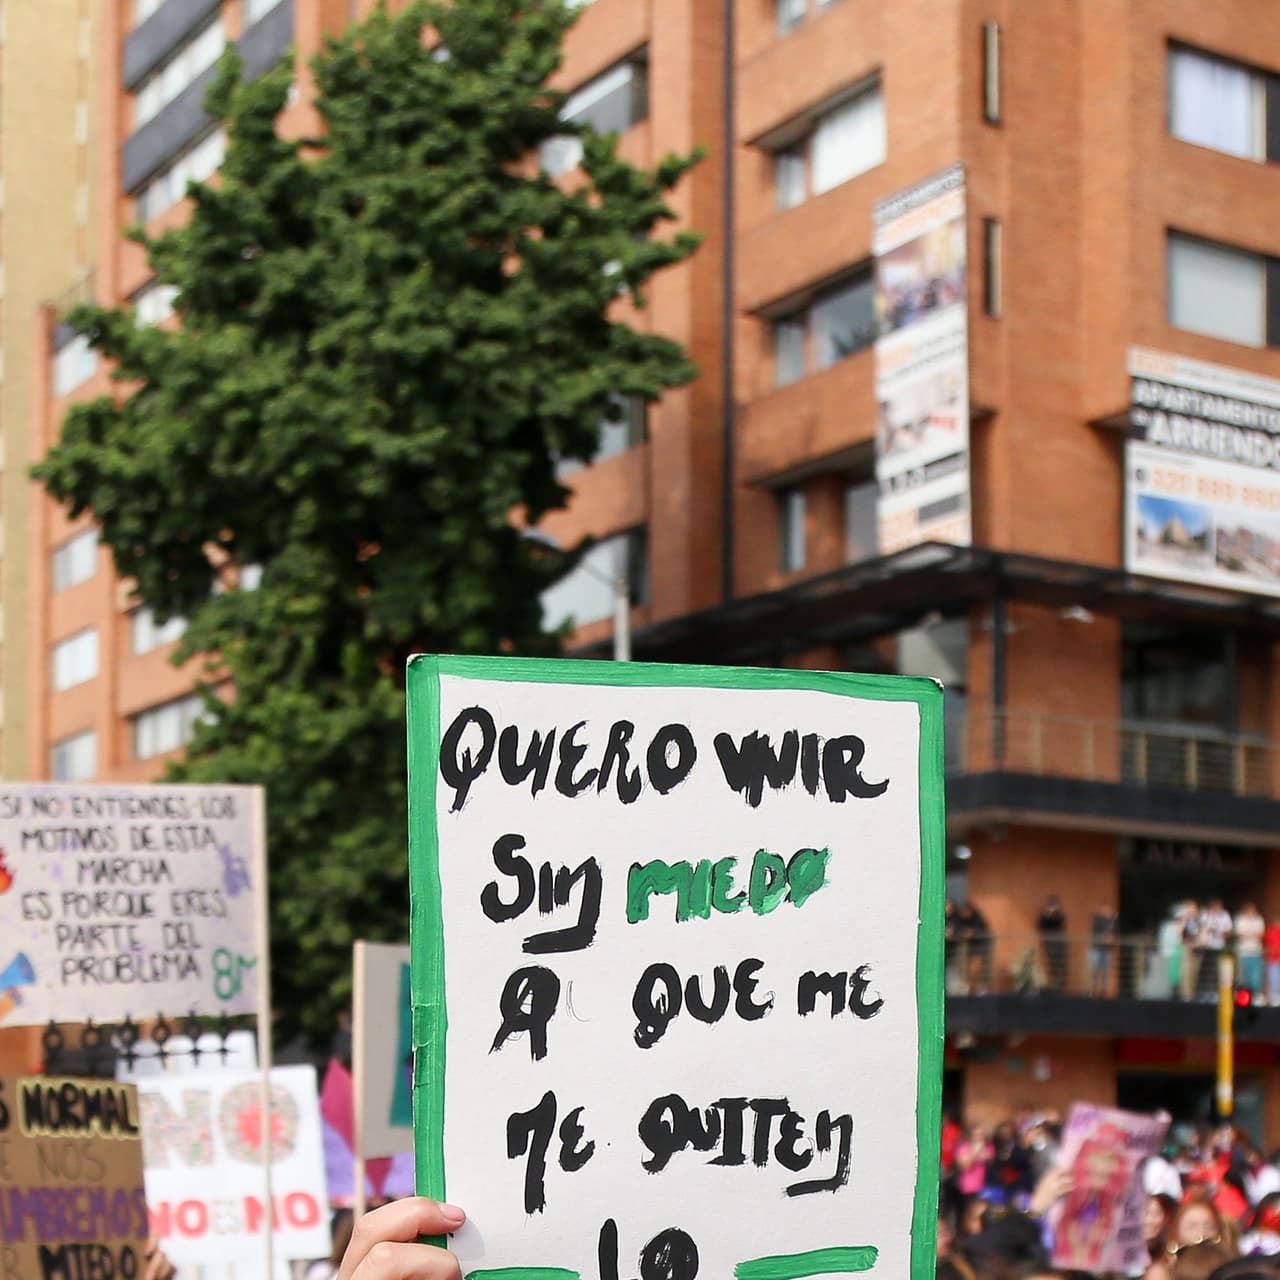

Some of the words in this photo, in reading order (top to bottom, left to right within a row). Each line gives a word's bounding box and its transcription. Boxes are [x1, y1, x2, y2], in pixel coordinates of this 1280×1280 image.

[31, 796, 61, 819] NO
[21, 827, 118, 852] MOTIVOS
[130, 826, 154, 851] DE
[162, 826, 218, 852] ESTA
[77, 858, 172, 885] MARCHA
[626, 846, 831, 924] MIEDO
[21, 891, 52, 921] ES
[62, 889, 155, 919] PORQUE
[171, 889, 228, 919] ERES
[56, 923, 140, 951] PARTE
[162, 922, 202, 950] DEL
[61, 955, 202, 986] PROBLEMA
[489, 964, 560, 1062] A
[632, 958, 773, 1049] QUE
[22, 1083, 139, 1134] NORMAL
[36, 1141, 105, 1182] NOS
[148, 1200, 208, 1237] NO
[244, 1192, 320, 1232] NO
